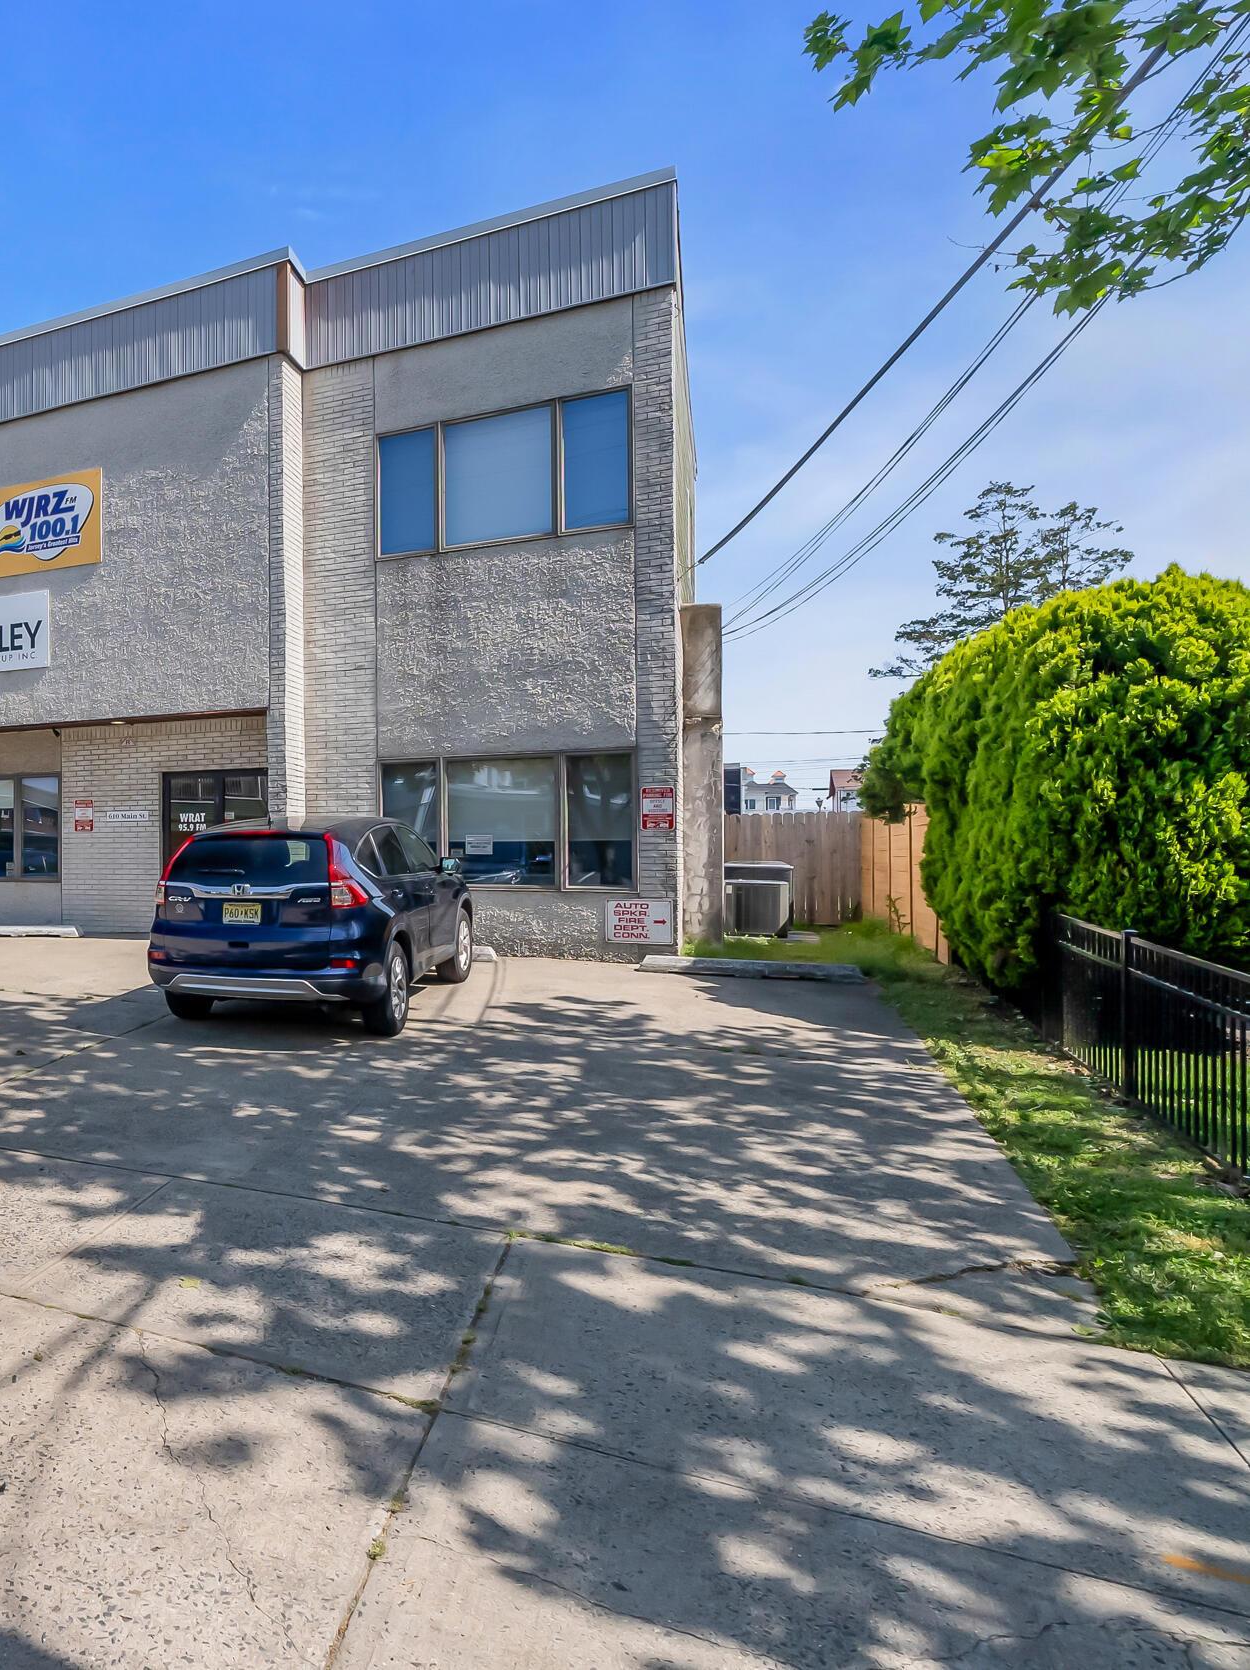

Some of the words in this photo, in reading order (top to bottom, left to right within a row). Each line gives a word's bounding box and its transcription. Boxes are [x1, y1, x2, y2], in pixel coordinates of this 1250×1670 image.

[4, 489, 75, 528] WJRZ
[65, 496, 77, 505] FM
[29, 514, 79, 542] 100.1
[179, 812, 206, 823] WRAT
[178, 823, 194, 832] 95.9
[196, 823, 207, 832] FM
[614, 902, 649, 910] AUTO
[613, 924, 649, 932] DEPT.
